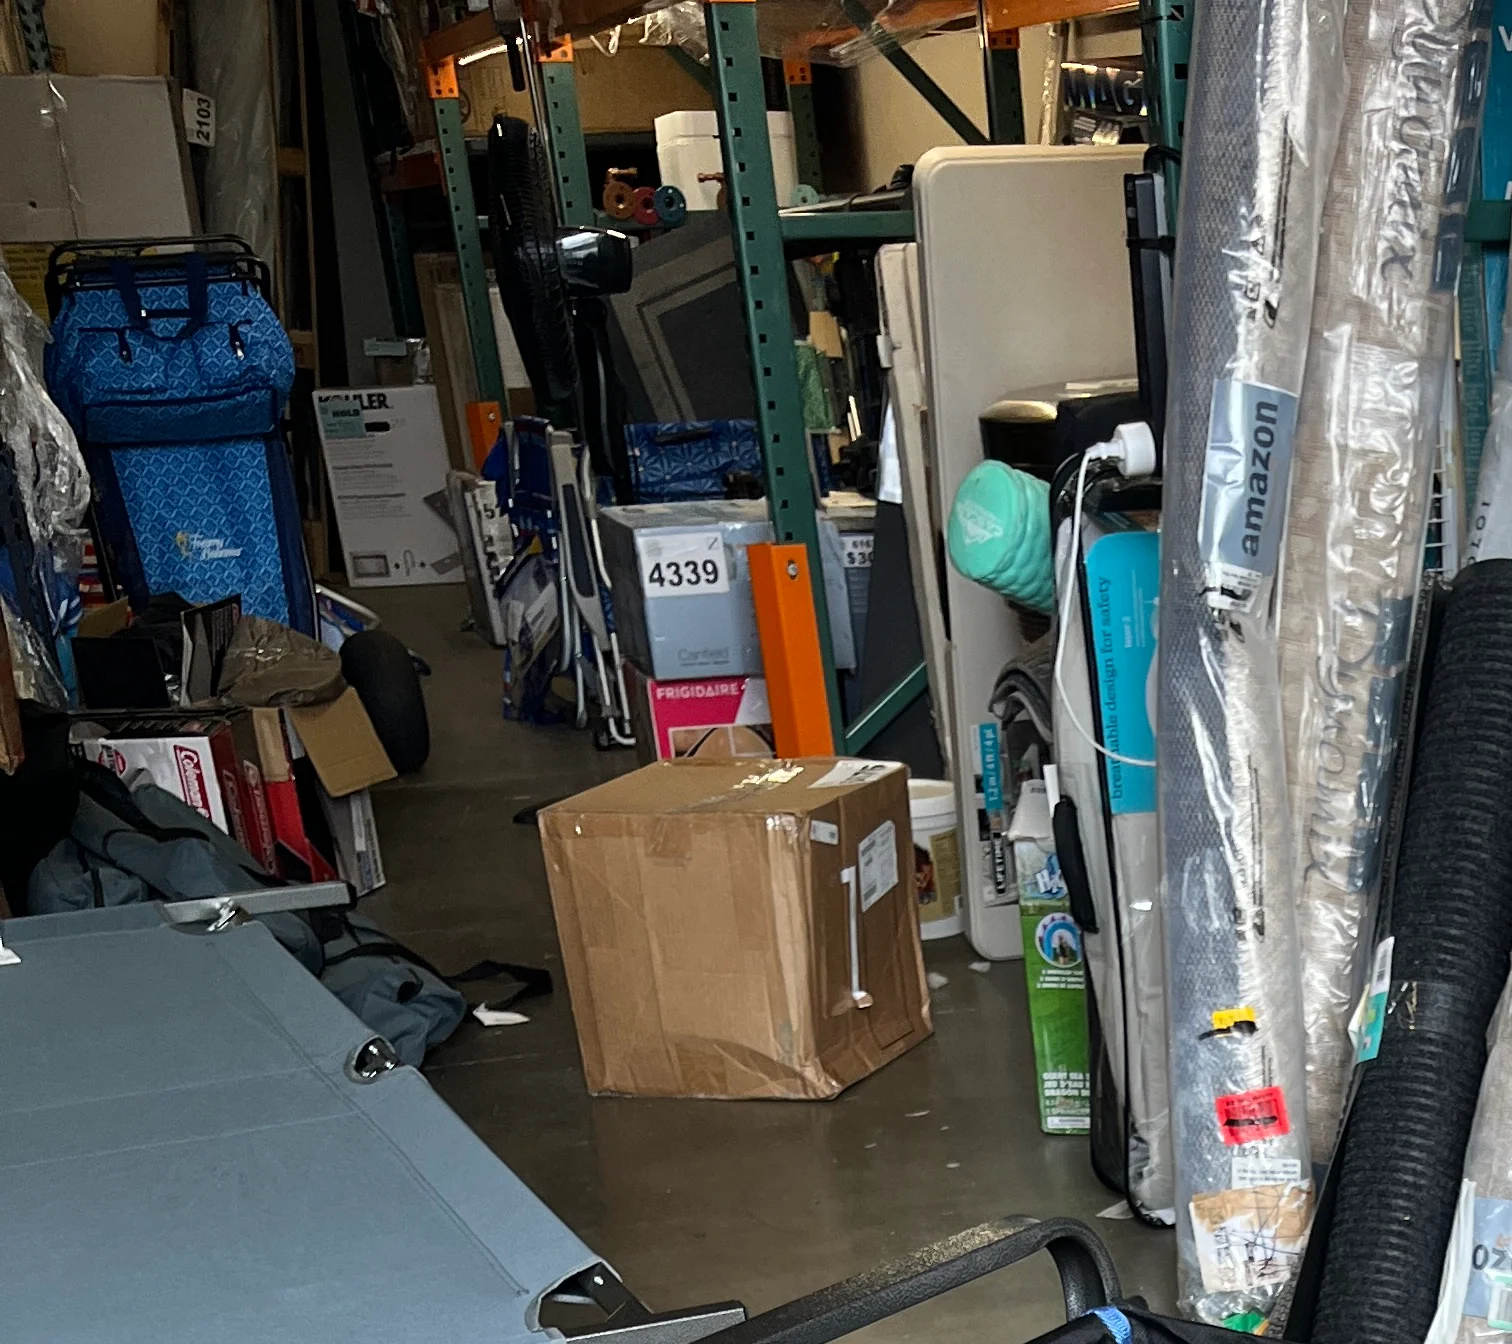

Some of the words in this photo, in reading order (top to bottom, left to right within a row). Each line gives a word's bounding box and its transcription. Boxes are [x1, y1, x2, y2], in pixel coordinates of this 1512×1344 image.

[196, 97, 211, 143] 2103
[1241, 400, 1279, 558] amazon
[648, 558, 719, 588] 4339
[1099, 575, 1112, 627] safety
[1101, 630, 1113, 651] for
[655, 682, 740, 700] FRIGIDAIRE
[1103, 655, 1119, 712] design
[1107, 714, 1123, 800] breaable
